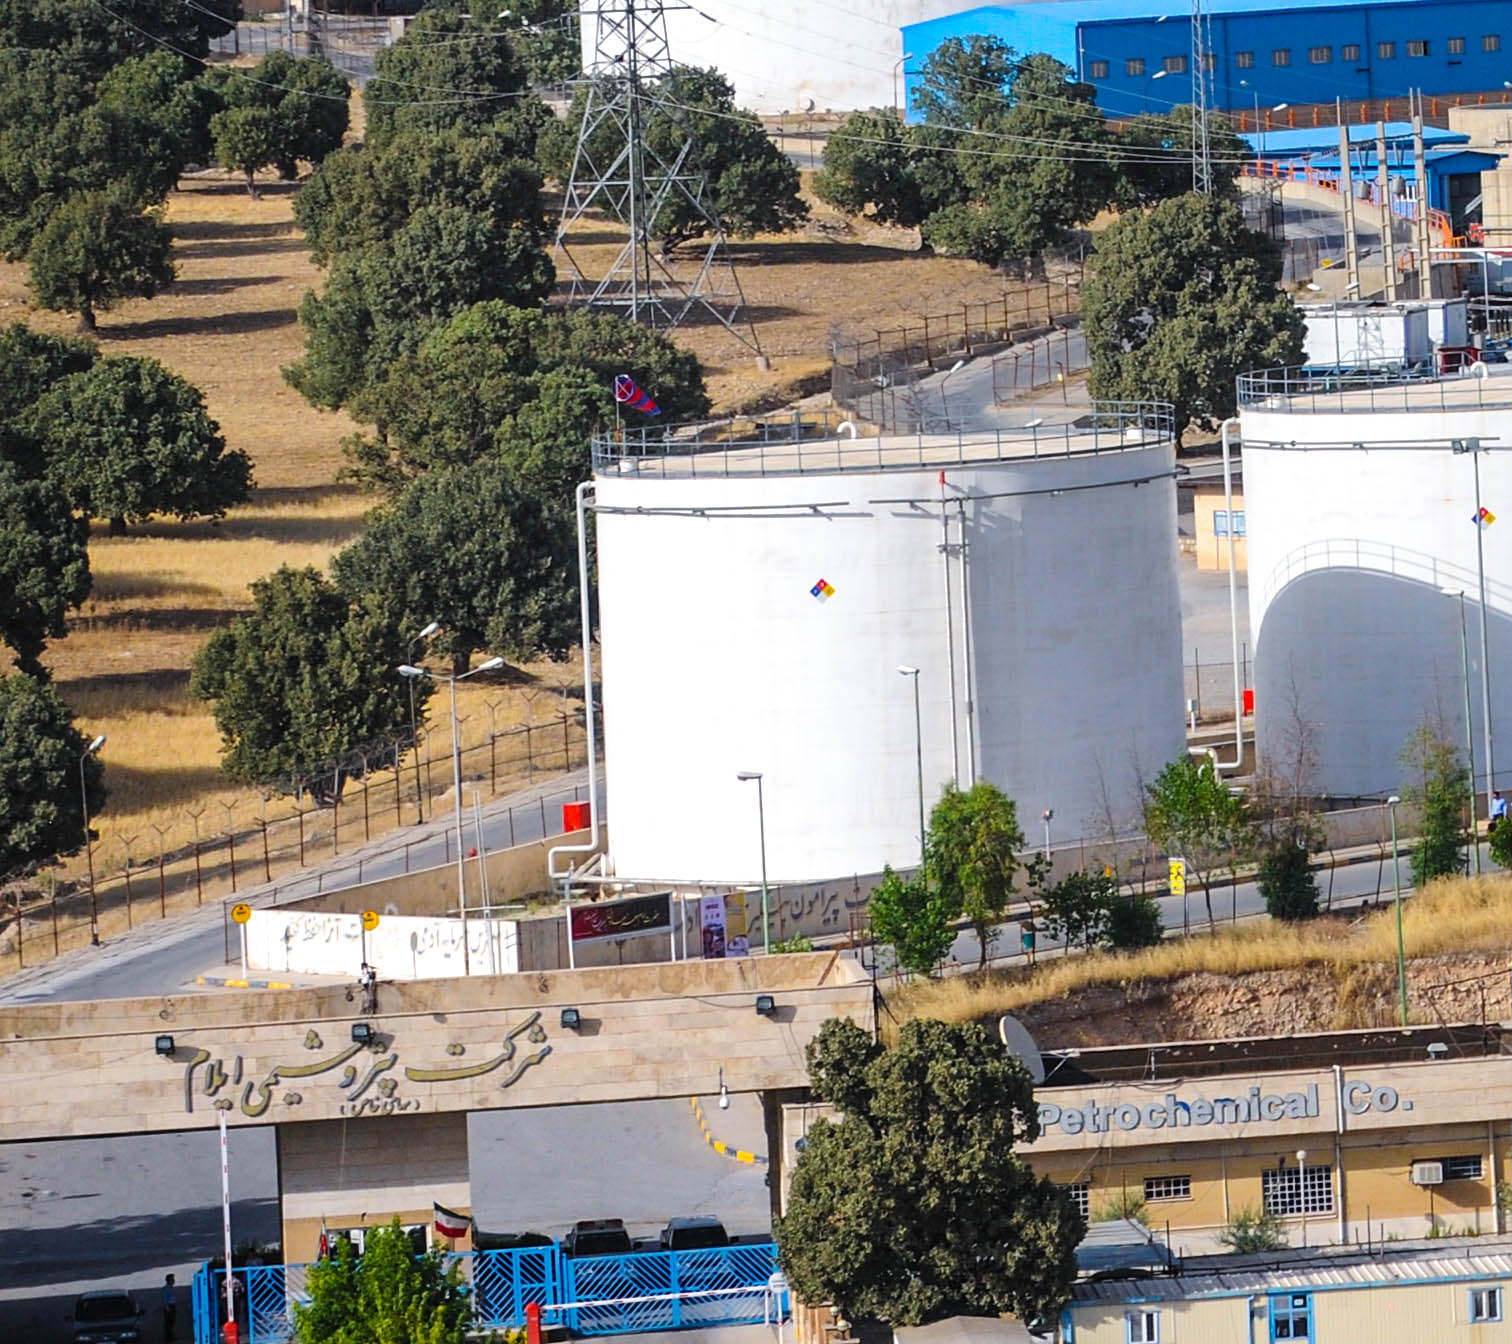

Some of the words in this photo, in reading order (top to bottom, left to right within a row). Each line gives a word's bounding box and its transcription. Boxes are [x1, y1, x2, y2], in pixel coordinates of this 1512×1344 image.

[184, 1048, 243, 1113] ایلام
[404, 1010, 553, 1089] شرکت
[1040, 1083, 1319, 1136] Petrochemical
[1342, 1079, 1414, 1114] Co.
